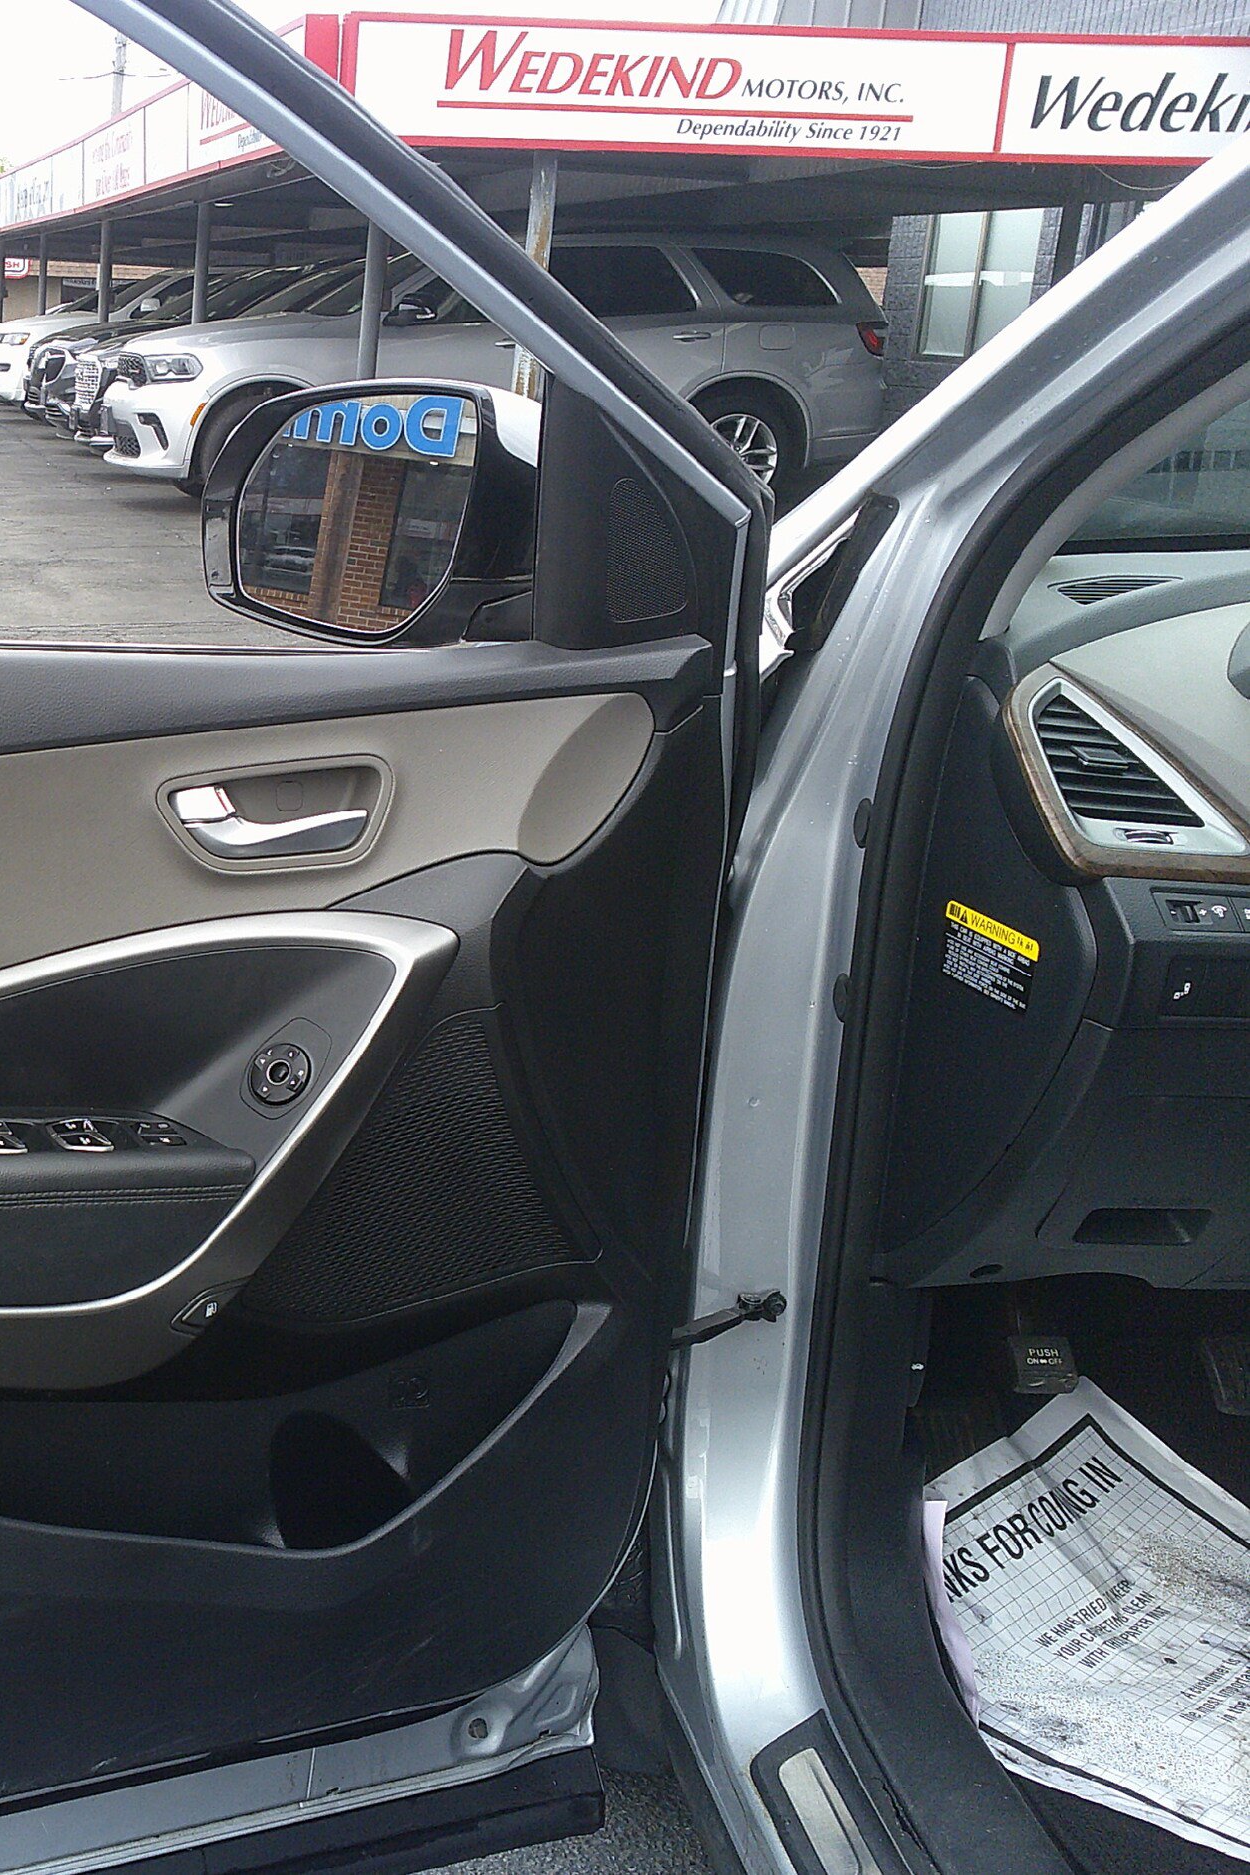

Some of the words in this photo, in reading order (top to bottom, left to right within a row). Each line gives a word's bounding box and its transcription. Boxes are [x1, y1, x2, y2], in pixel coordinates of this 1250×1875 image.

[445, 28, 744, 100] WEDEKIND
[741, 78, 849, 105] MOTORS,
[857, 82, 905, 103] INC.
[1030, 72, 1250, 133] Wedeki
[676, 118, 802, 143] Dependability
[805, 122, 854, 140] Since
[859, 125, 902, 142] 1921
[970, 913, 1016, 945] WARNING
[1028, 1348, 1059, 1357] PUSH
[943, 1546, 990, 1603] NKS
[976, 1513, 1043, 1570] FOR
[1078, 1455, 1124, 1494] IN
[1035, 1632, 1058, 1648] WE
[1051, 1616, 1079, 1638] HAVE
[1073, 1597, 1108, 1625] TRIED
[1053, 1638, 1088, 1661] YOUR
[1121, 1590, 1156, 1615] CLEAN
[1078, 1647, 1111, 1669] WITH
[1119, 1617, 1155, 1640] PAPER
[1180, 1690, 1197, 1700] A
[1189, 1665, 1232, 1695] customer
[1212, 1665, 1250, 1698] importa
